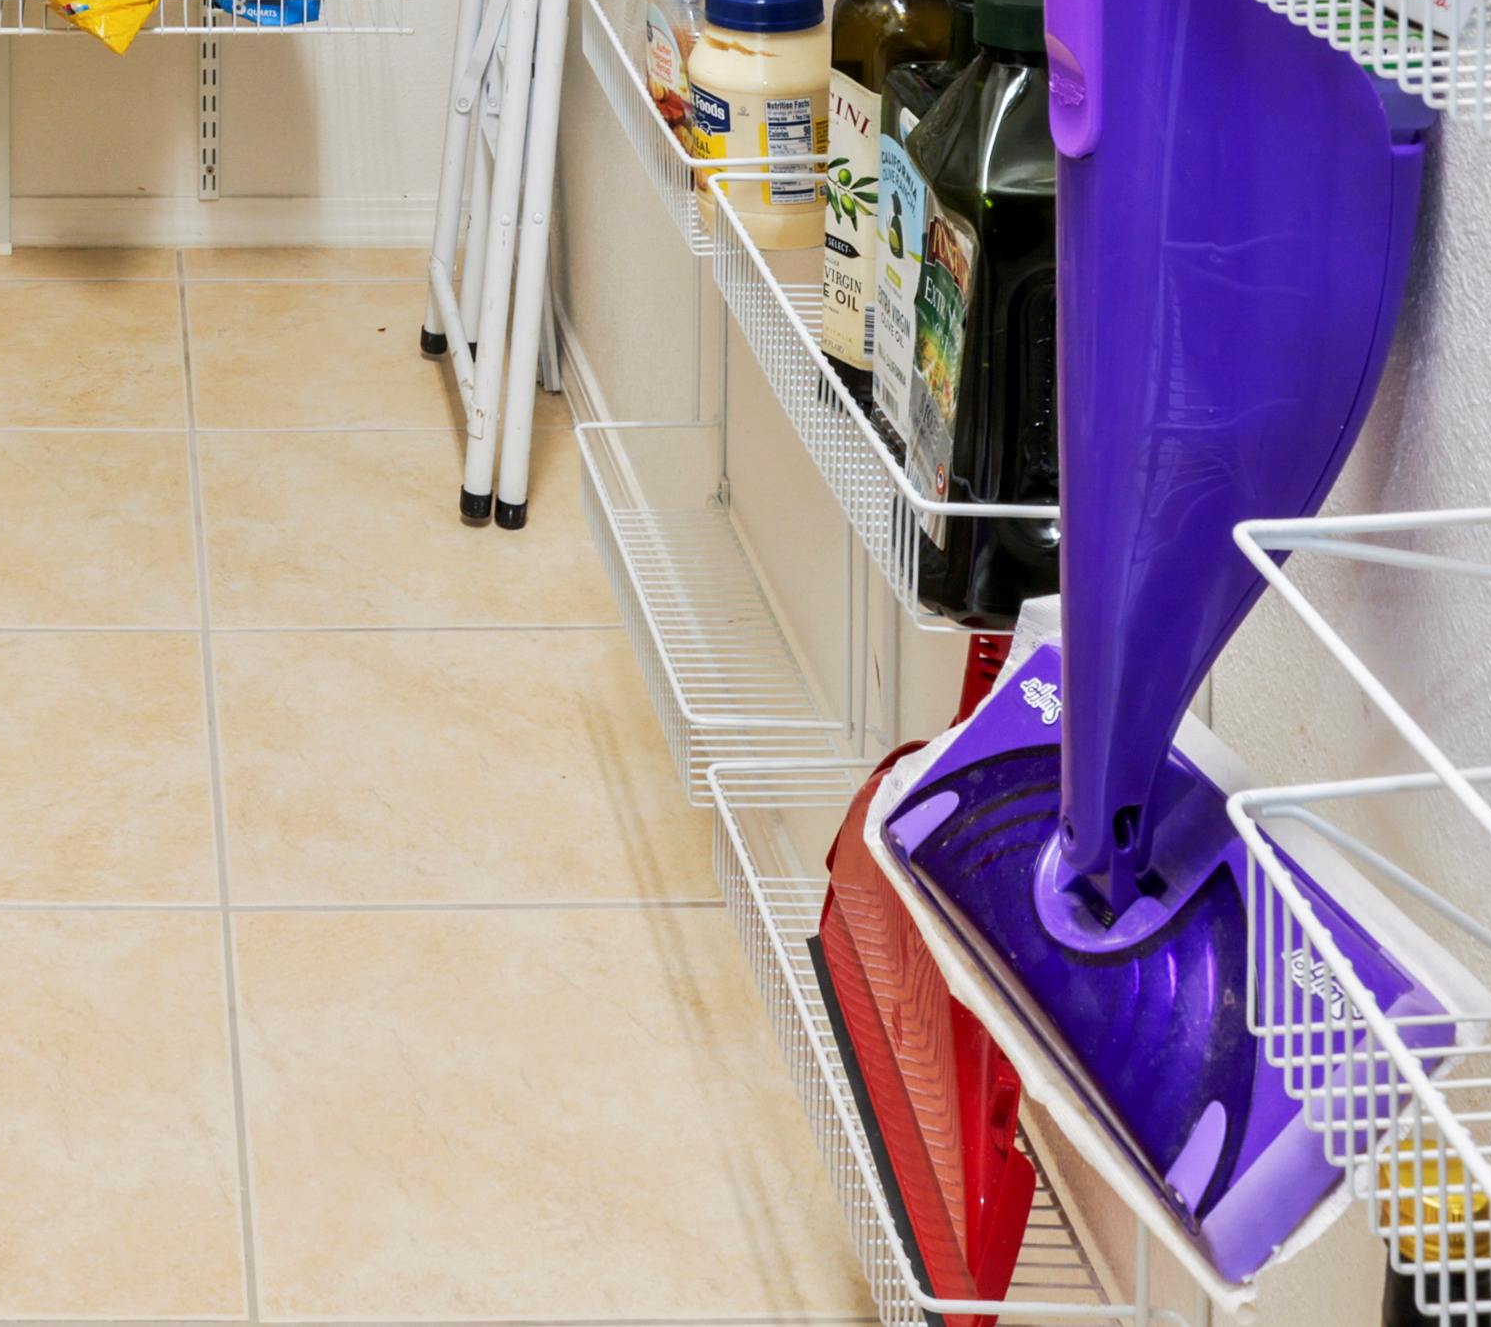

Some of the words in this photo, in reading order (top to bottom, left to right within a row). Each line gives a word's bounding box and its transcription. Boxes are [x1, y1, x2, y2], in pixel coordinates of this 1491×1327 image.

[245, 7, 279, 18] QUARTS
[694, 94, 727, 122] Foods
[766, 100, 793, 110] Nutrition
[794, 99, 810, 108] Facts
[768, 130, 789, 138] Calories
[834, 288, 860, 314] OIL
